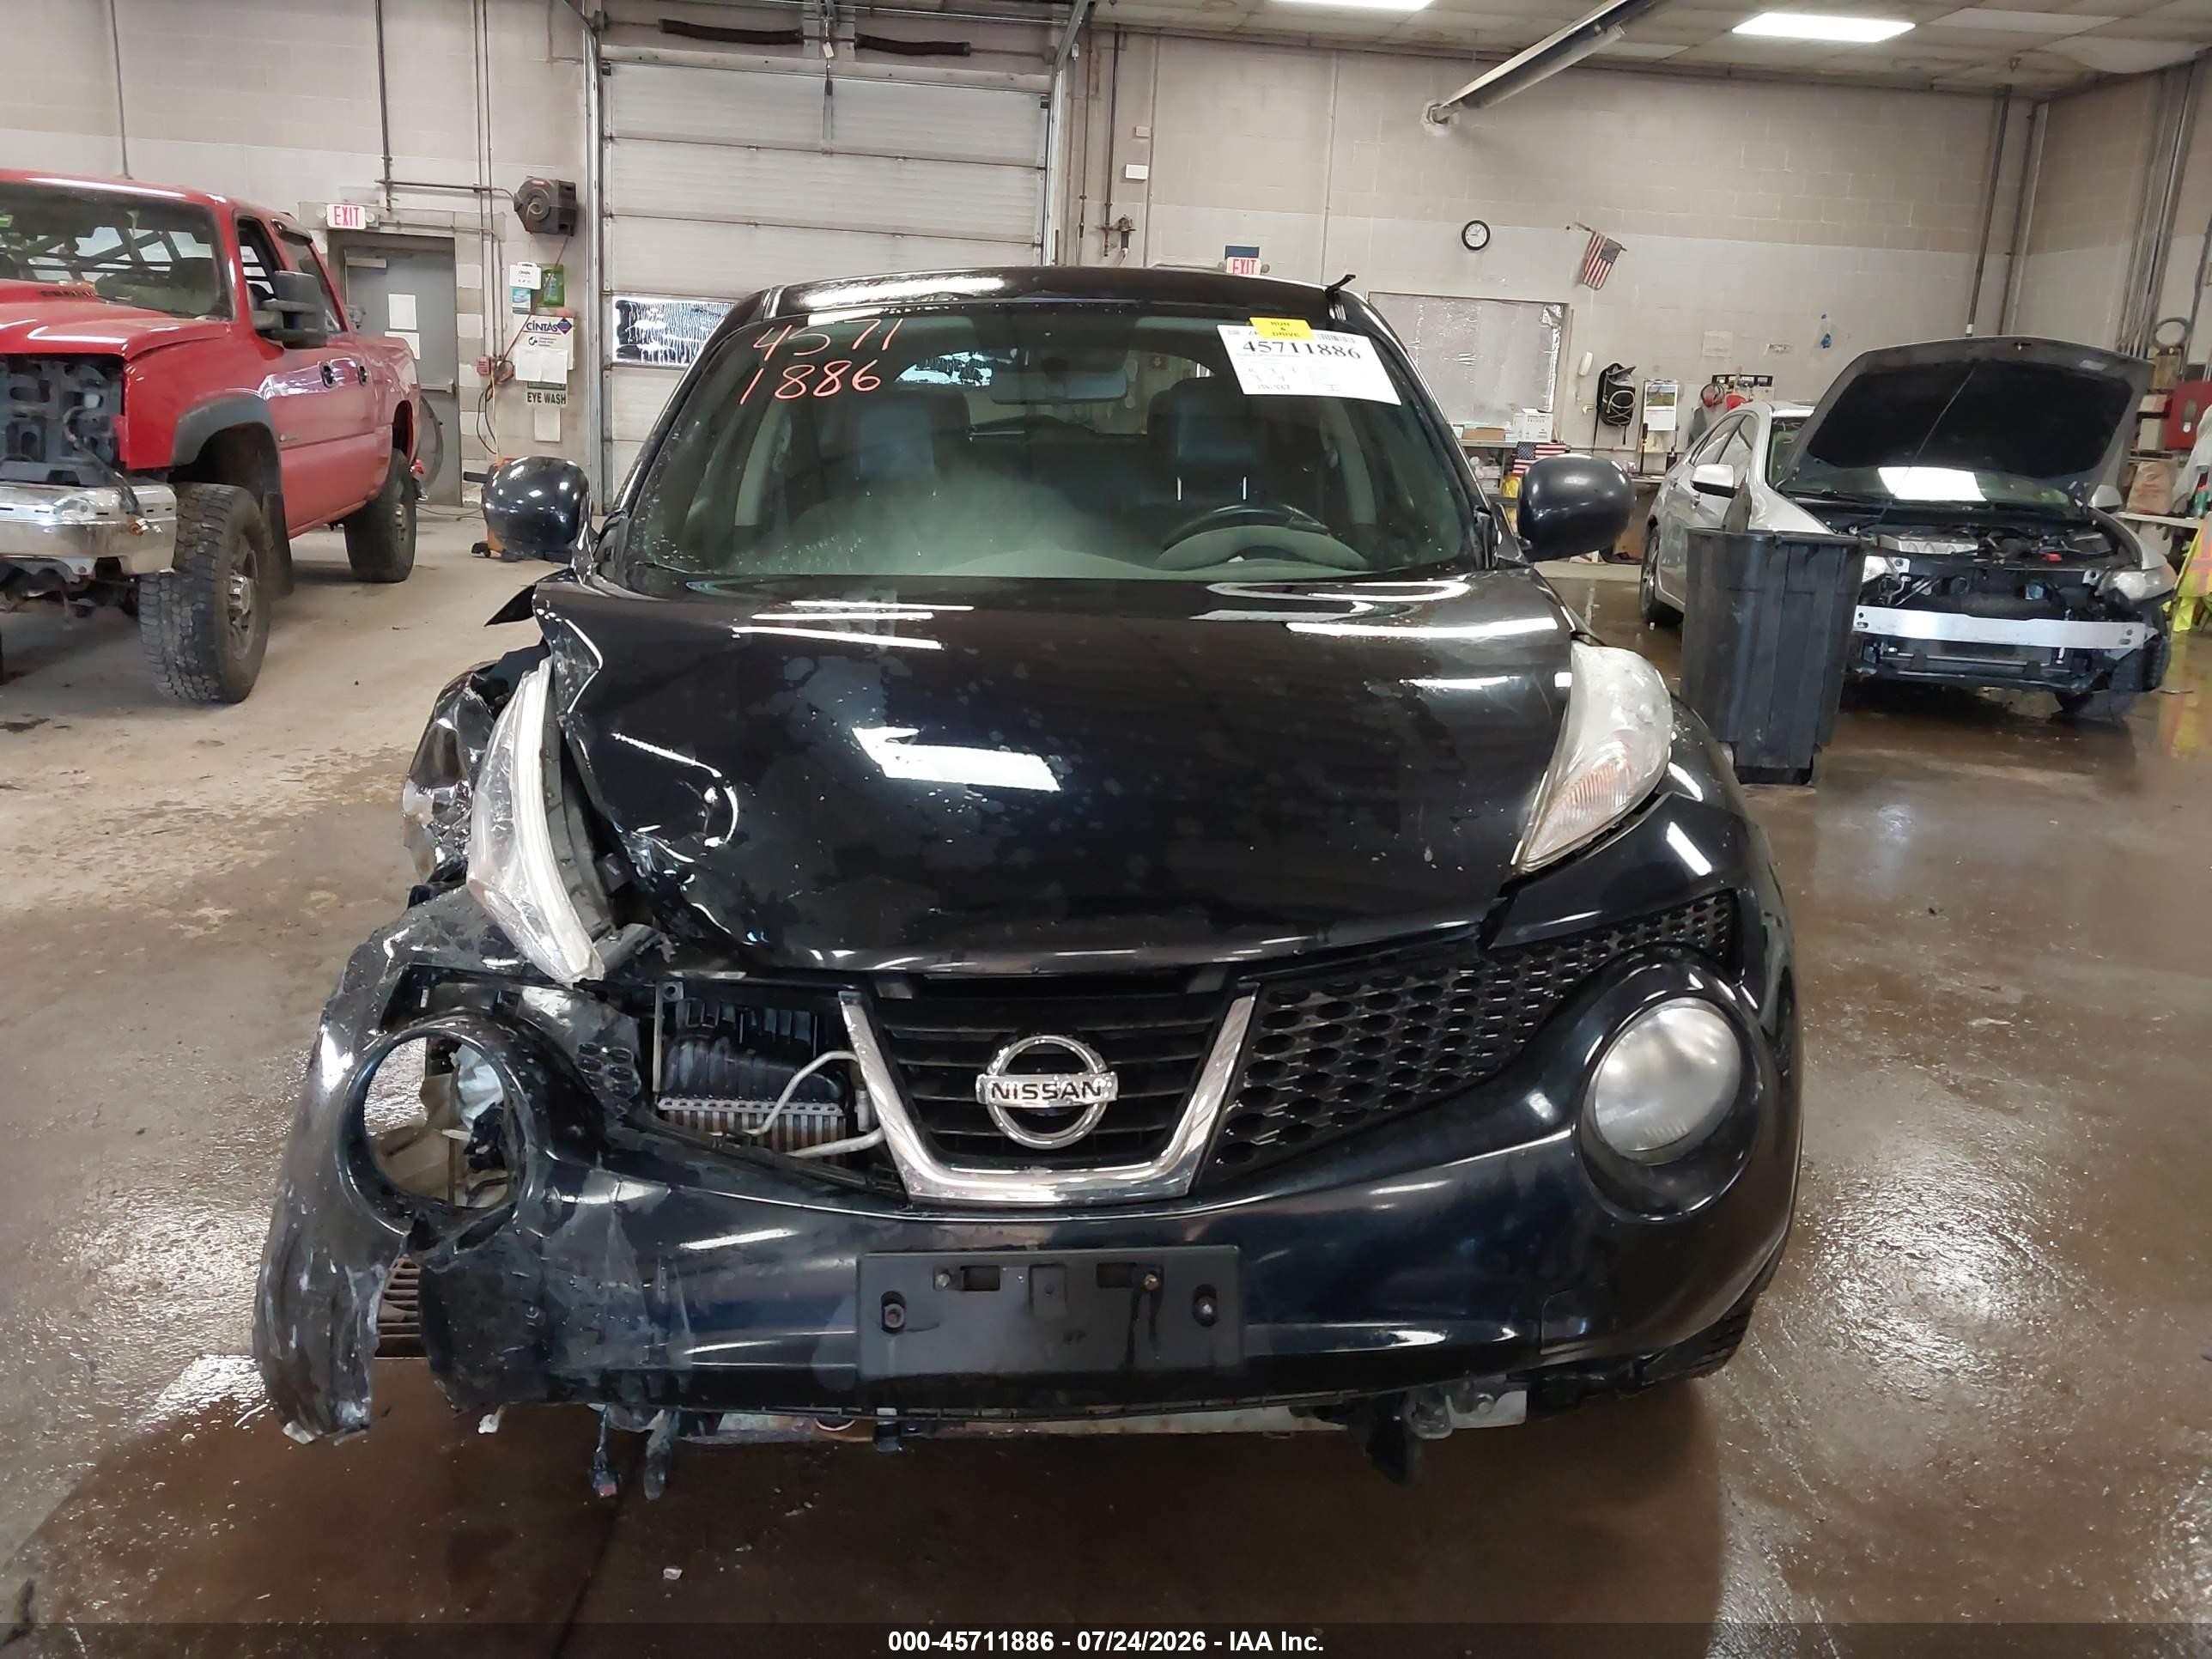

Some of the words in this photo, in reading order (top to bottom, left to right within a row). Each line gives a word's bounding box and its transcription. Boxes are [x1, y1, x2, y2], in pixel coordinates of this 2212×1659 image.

[334, 205, 360, 227] EXIT
[1233, 258, 1256, 275] EXIT
[526, 320, 558, 332] CINTAS
[752, 317, 904, 362] 4571
[1243, 340, 1361, 360] 45711886
[739, 359, 881, 405] 1886
[527, 392, 543, 403] EYE
[544, 392, 567, 404] WASH
[991, 1080, 1102, 1101] NISSAN
